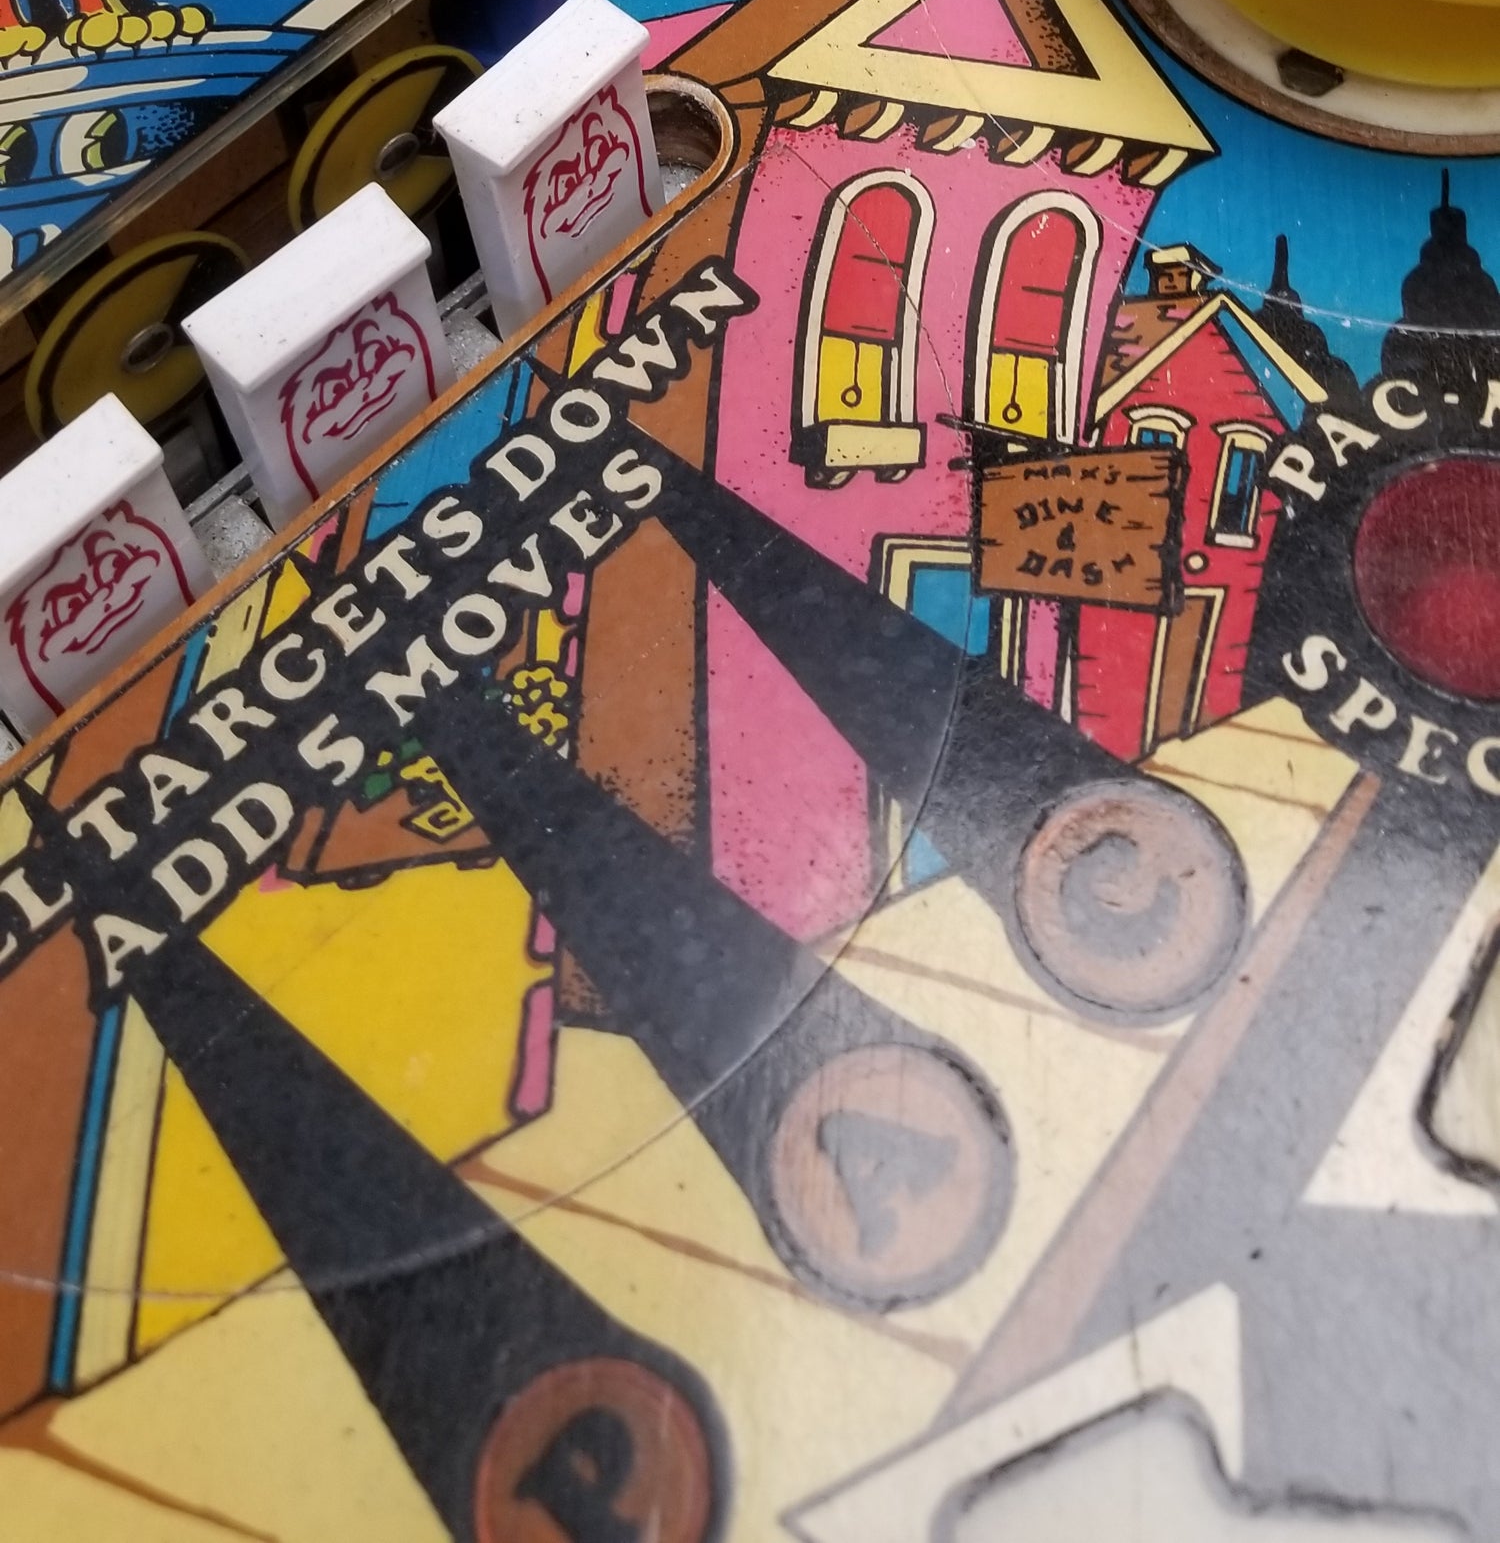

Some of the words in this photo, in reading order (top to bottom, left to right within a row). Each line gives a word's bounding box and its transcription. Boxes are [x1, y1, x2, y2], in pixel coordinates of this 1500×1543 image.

[68, 497, 484, 861] TARGETS
[487, 267, 746, 502] DOWN
[91, 781, 295, 988] ADD
[365, 449, 664, 729] MOVES
[1014, 497, 1123, 530] DINE
